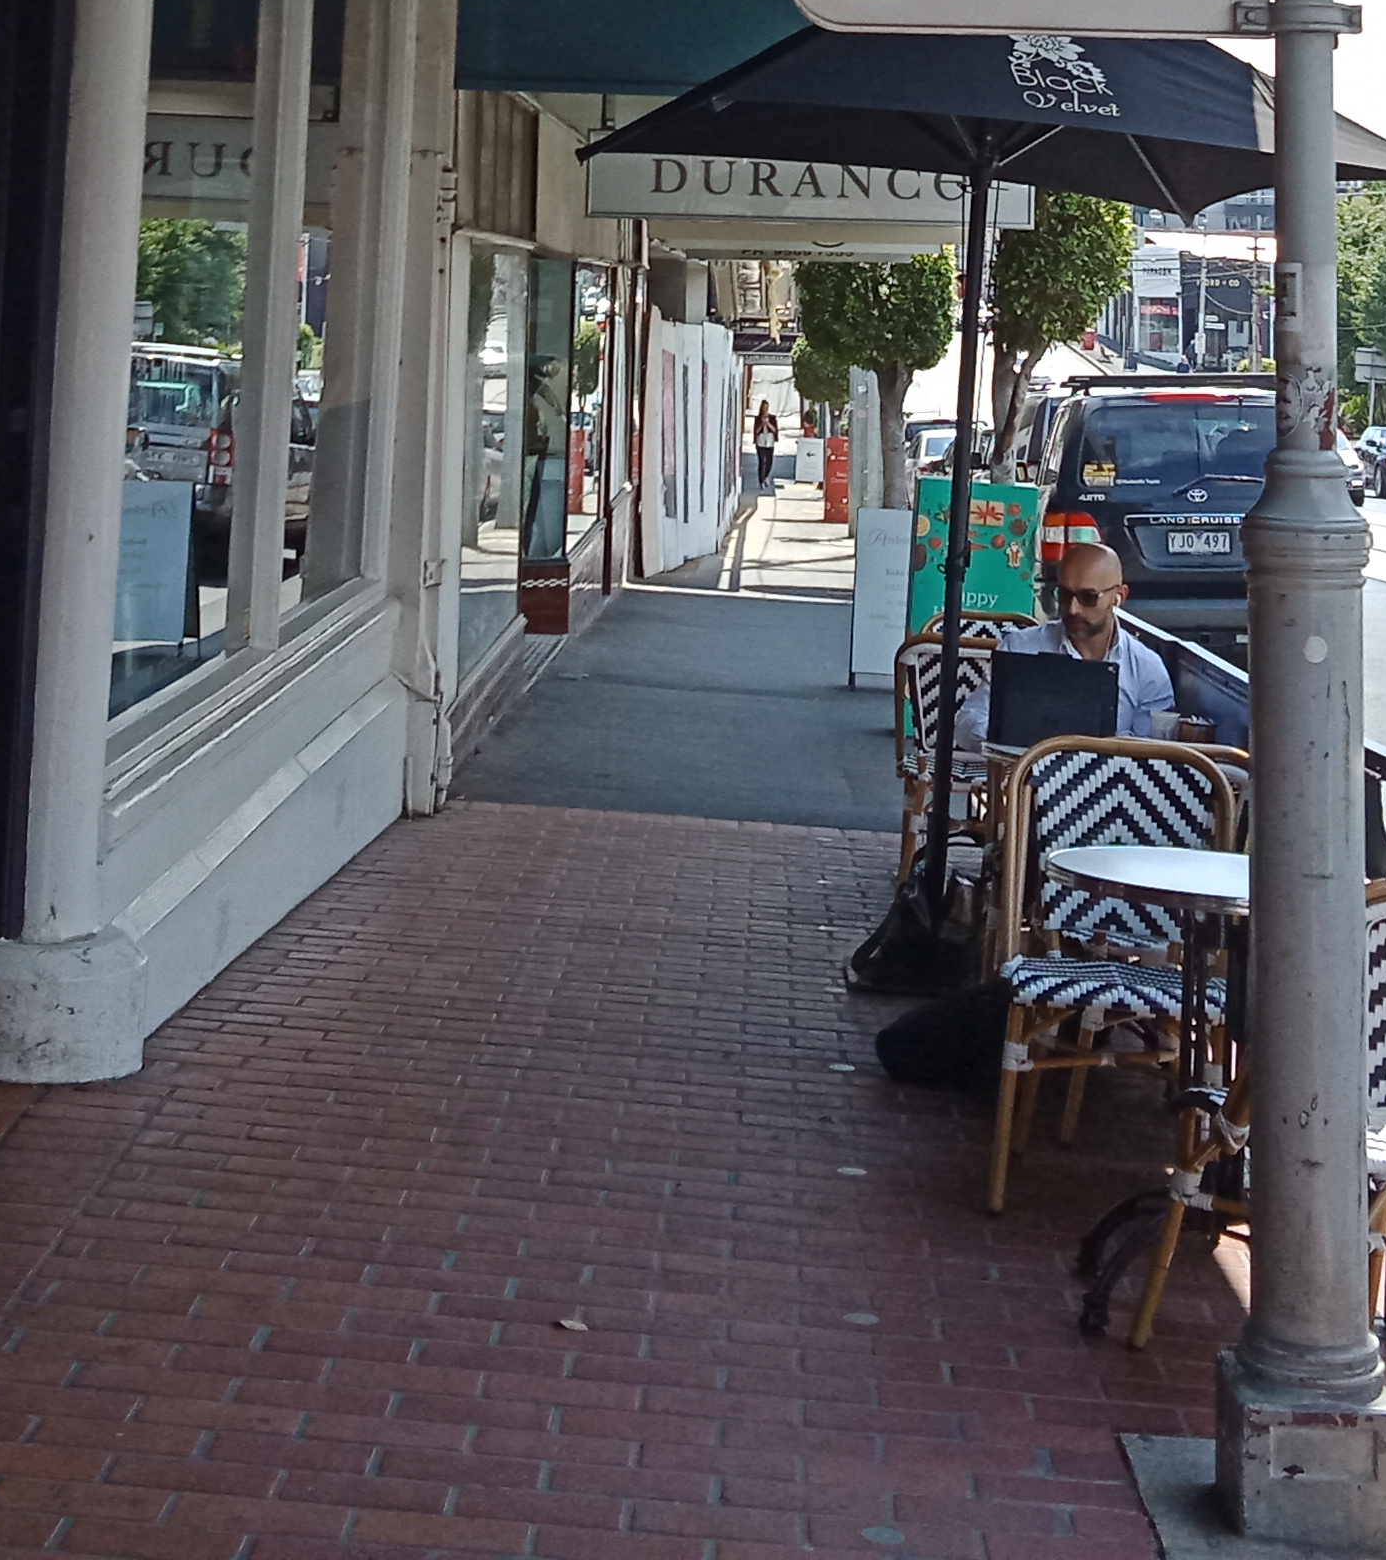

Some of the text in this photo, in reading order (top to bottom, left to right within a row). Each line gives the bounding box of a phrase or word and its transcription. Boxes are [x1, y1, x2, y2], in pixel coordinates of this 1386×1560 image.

[1011, 62, 1114, 96] Black
[1023, 89, 1121, 117] Velvet
[1149, 516, 1243, 525] LAND CRUISE
[1204, 535, 1228, 550] 497
[961, 591, 999, 608] ppy
